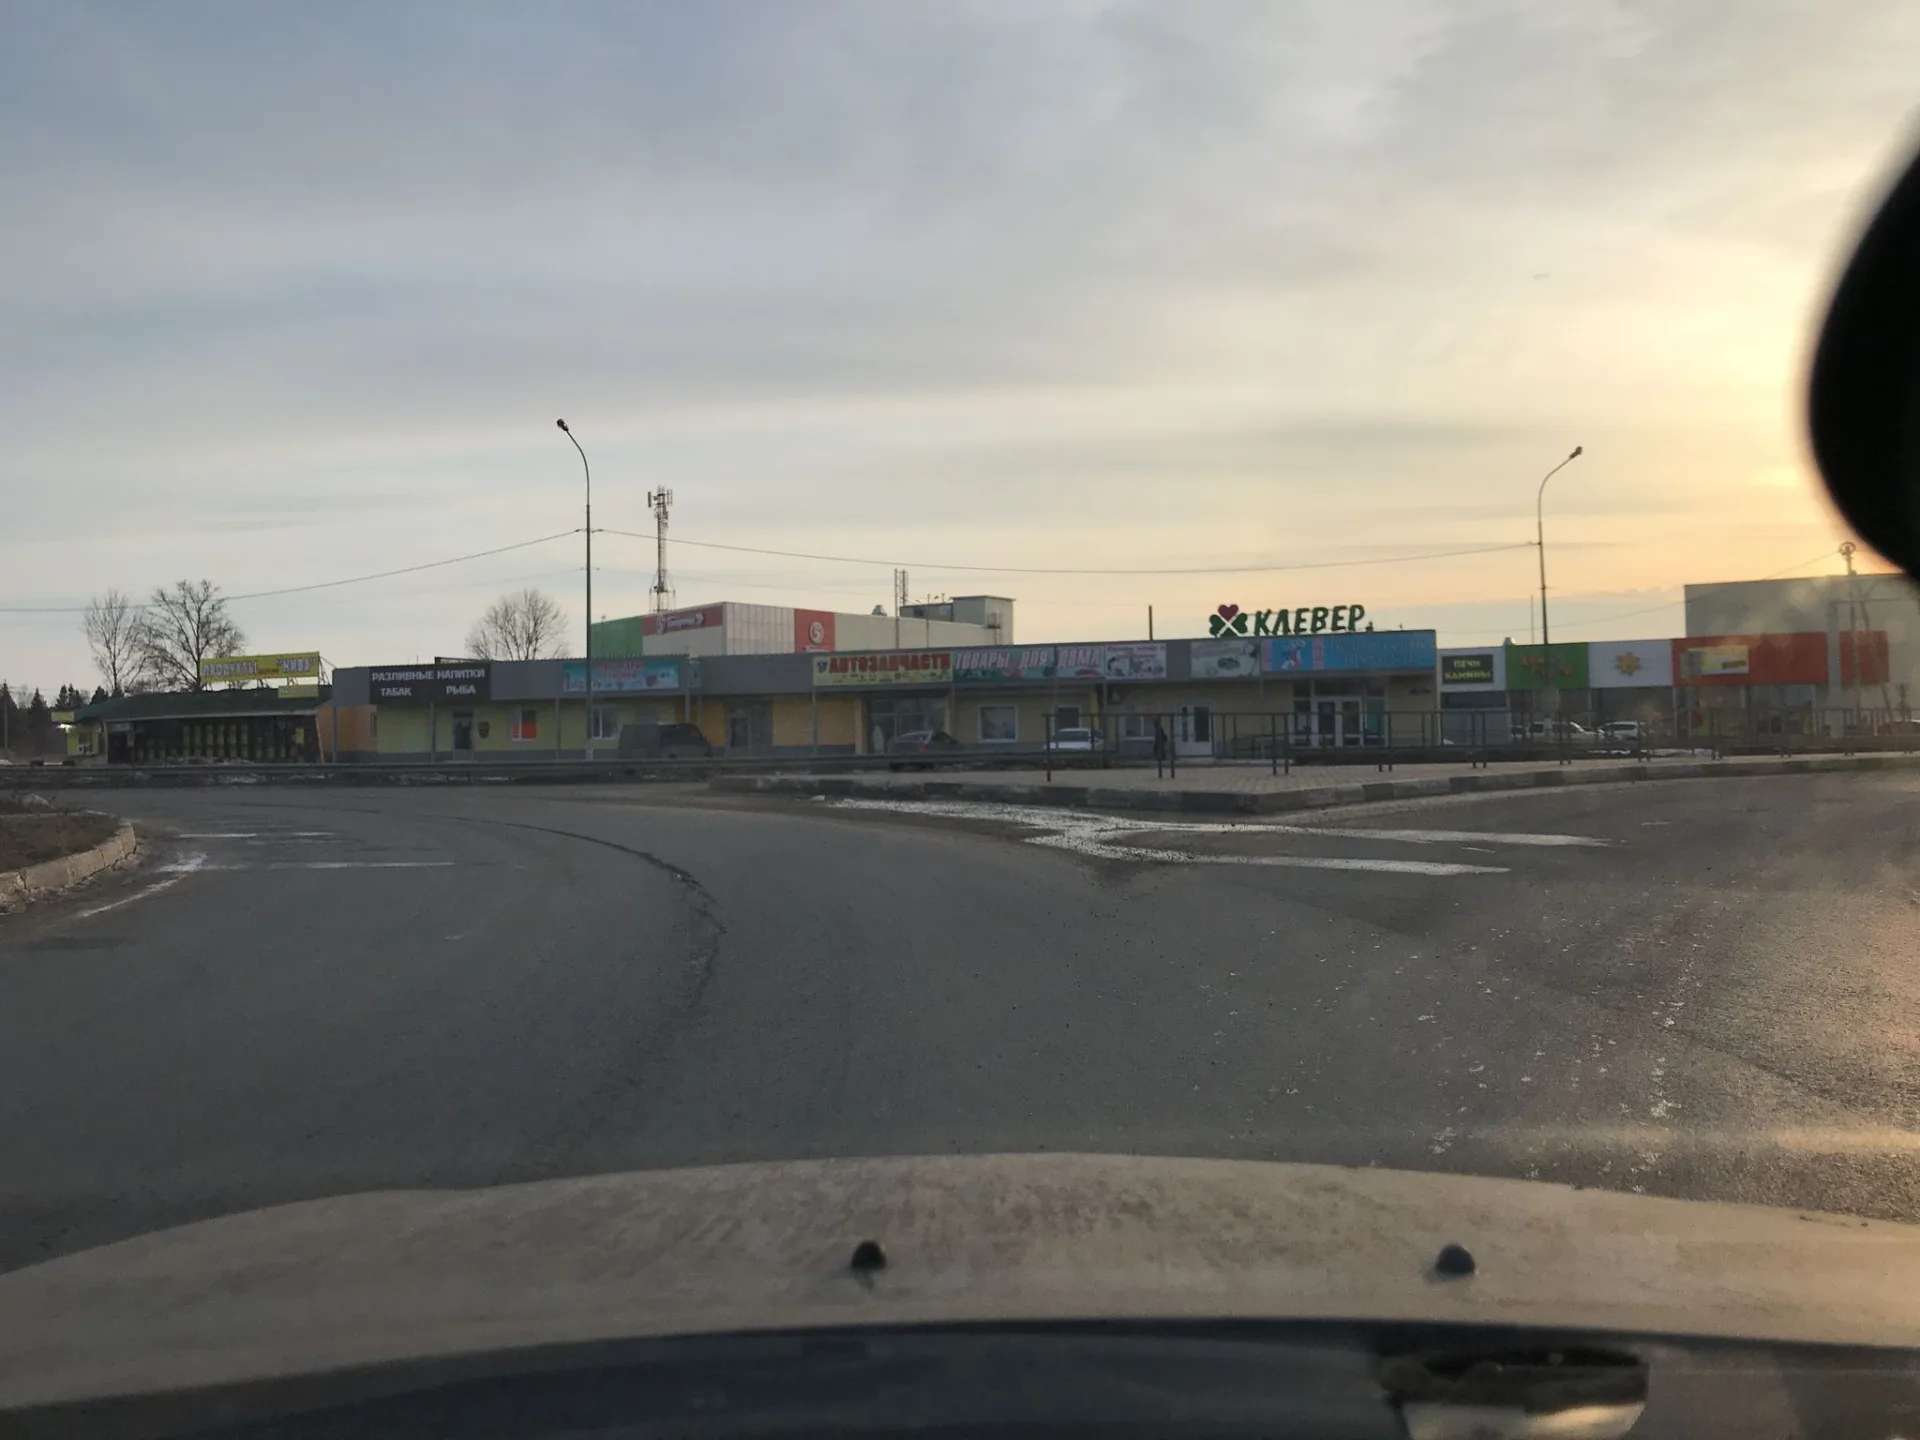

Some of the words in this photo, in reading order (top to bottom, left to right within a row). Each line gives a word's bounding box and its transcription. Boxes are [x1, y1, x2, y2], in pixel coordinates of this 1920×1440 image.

[1254, 604, 1366, 636] КЛЕВЕР
[828, 653, 951, 673] АВТОЗАПЧАСТИ
[955, 651, 1010, 669] ТОВАРЫ
[1057, 647, 1100, 668] ДОМА
[1453, 659, 1481, 668] ПЕЧИ
[371, 670, 434, 682] РАЗЛИВНЫЕ
[437, 668, 485, 680] НАПИТКИ
[1444, 670, 1491, 680] КАМИНЫ
[380, 687, 412, 697] ТАБАК
[446, 685, 476, 695] РЫБА
